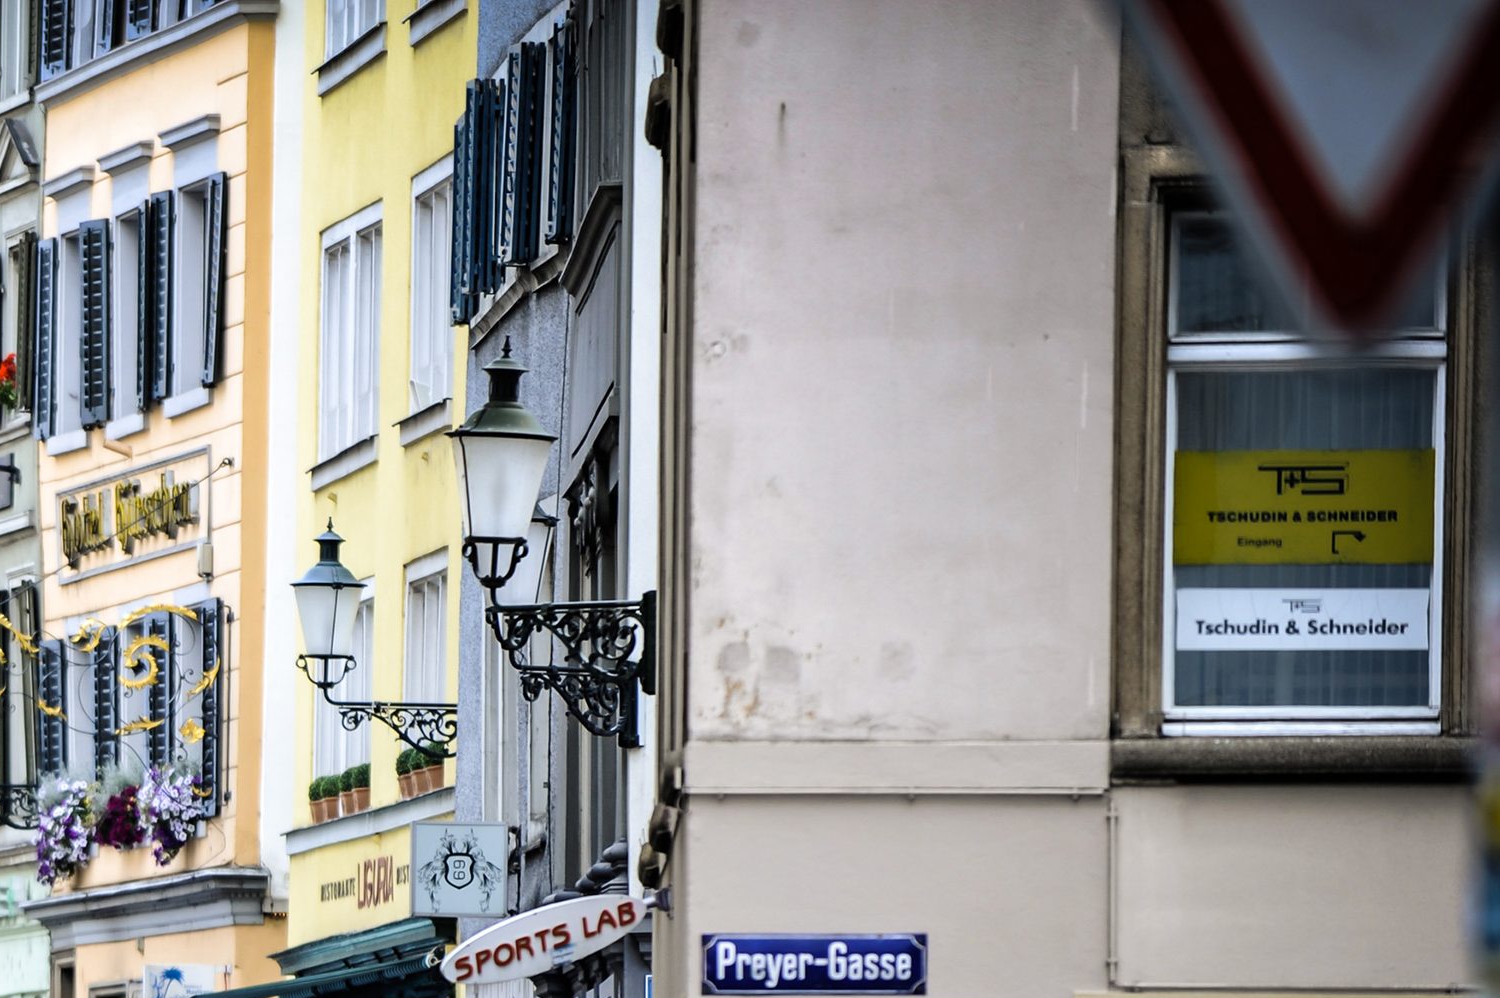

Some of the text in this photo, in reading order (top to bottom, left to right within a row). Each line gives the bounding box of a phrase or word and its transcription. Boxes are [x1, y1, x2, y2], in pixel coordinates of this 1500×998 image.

[1207, 510, 1399, 523] TSCHUDIN & SCHNEIDER
[1237, 536, 1283, 548] Eingang
[1196, 619, 1409, 635] Tschudin & Schneider
[320, 877, 356, 903] RISTORANTE
[357, 855, 394, 910] LIGURIA
[454, 923, 571, 982] SPORTS
[582, 901, 636, 939] LAB
[715, 941, 912, 989] Preyer-Gasse
